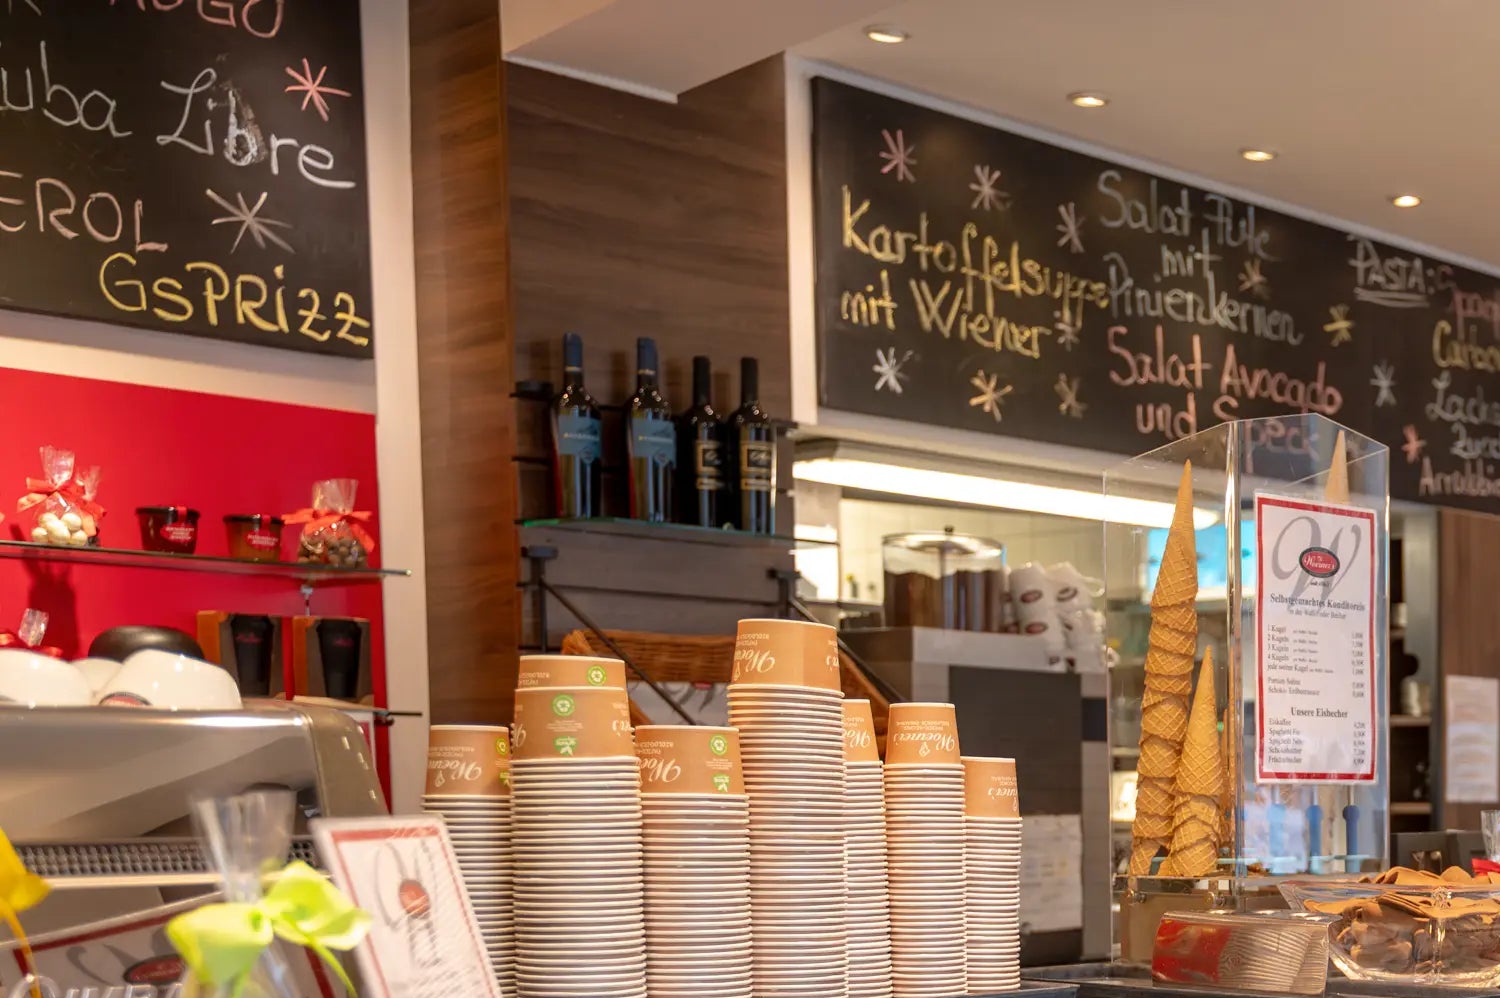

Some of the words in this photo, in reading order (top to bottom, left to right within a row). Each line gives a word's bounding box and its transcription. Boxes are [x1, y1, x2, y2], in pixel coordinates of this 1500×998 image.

[156, 67, 356, 189] Libre
[1097, 169, 1194, 238] Salat
[1160, 227, 1223, 279] mit
[841, 268, 898, 331] mit
[909, 278, 1053, 359] Wiener
[1107, 324, 1213, 389] Salat
[1220, 343, 1344, 416] Avocado
[1135, 391, 1198, 441] und
